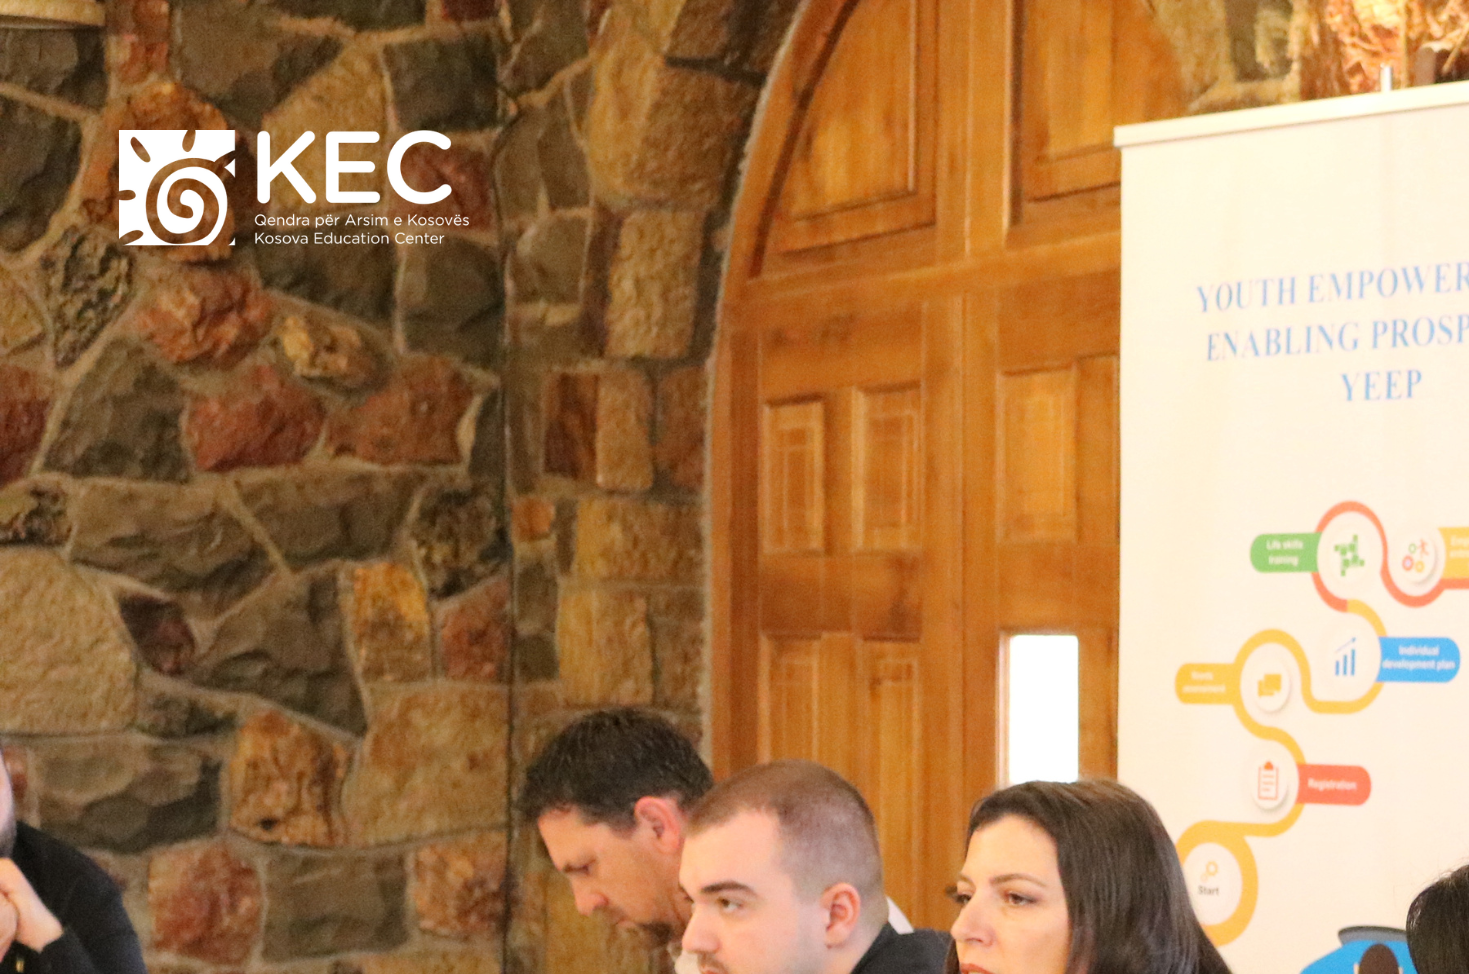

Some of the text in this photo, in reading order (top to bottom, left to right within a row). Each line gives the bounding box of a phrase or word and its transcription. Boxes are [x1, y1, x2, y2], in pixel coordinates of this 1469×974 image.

[1197, 276, 1296, 314] YOUTH
[1206, 322, 1359, 361] ENABLING
[1341, 369, 1422, 401] YEEP
[1308, 778, 1357, 791] Registration
[1198, 885, 1219, 896] Start
